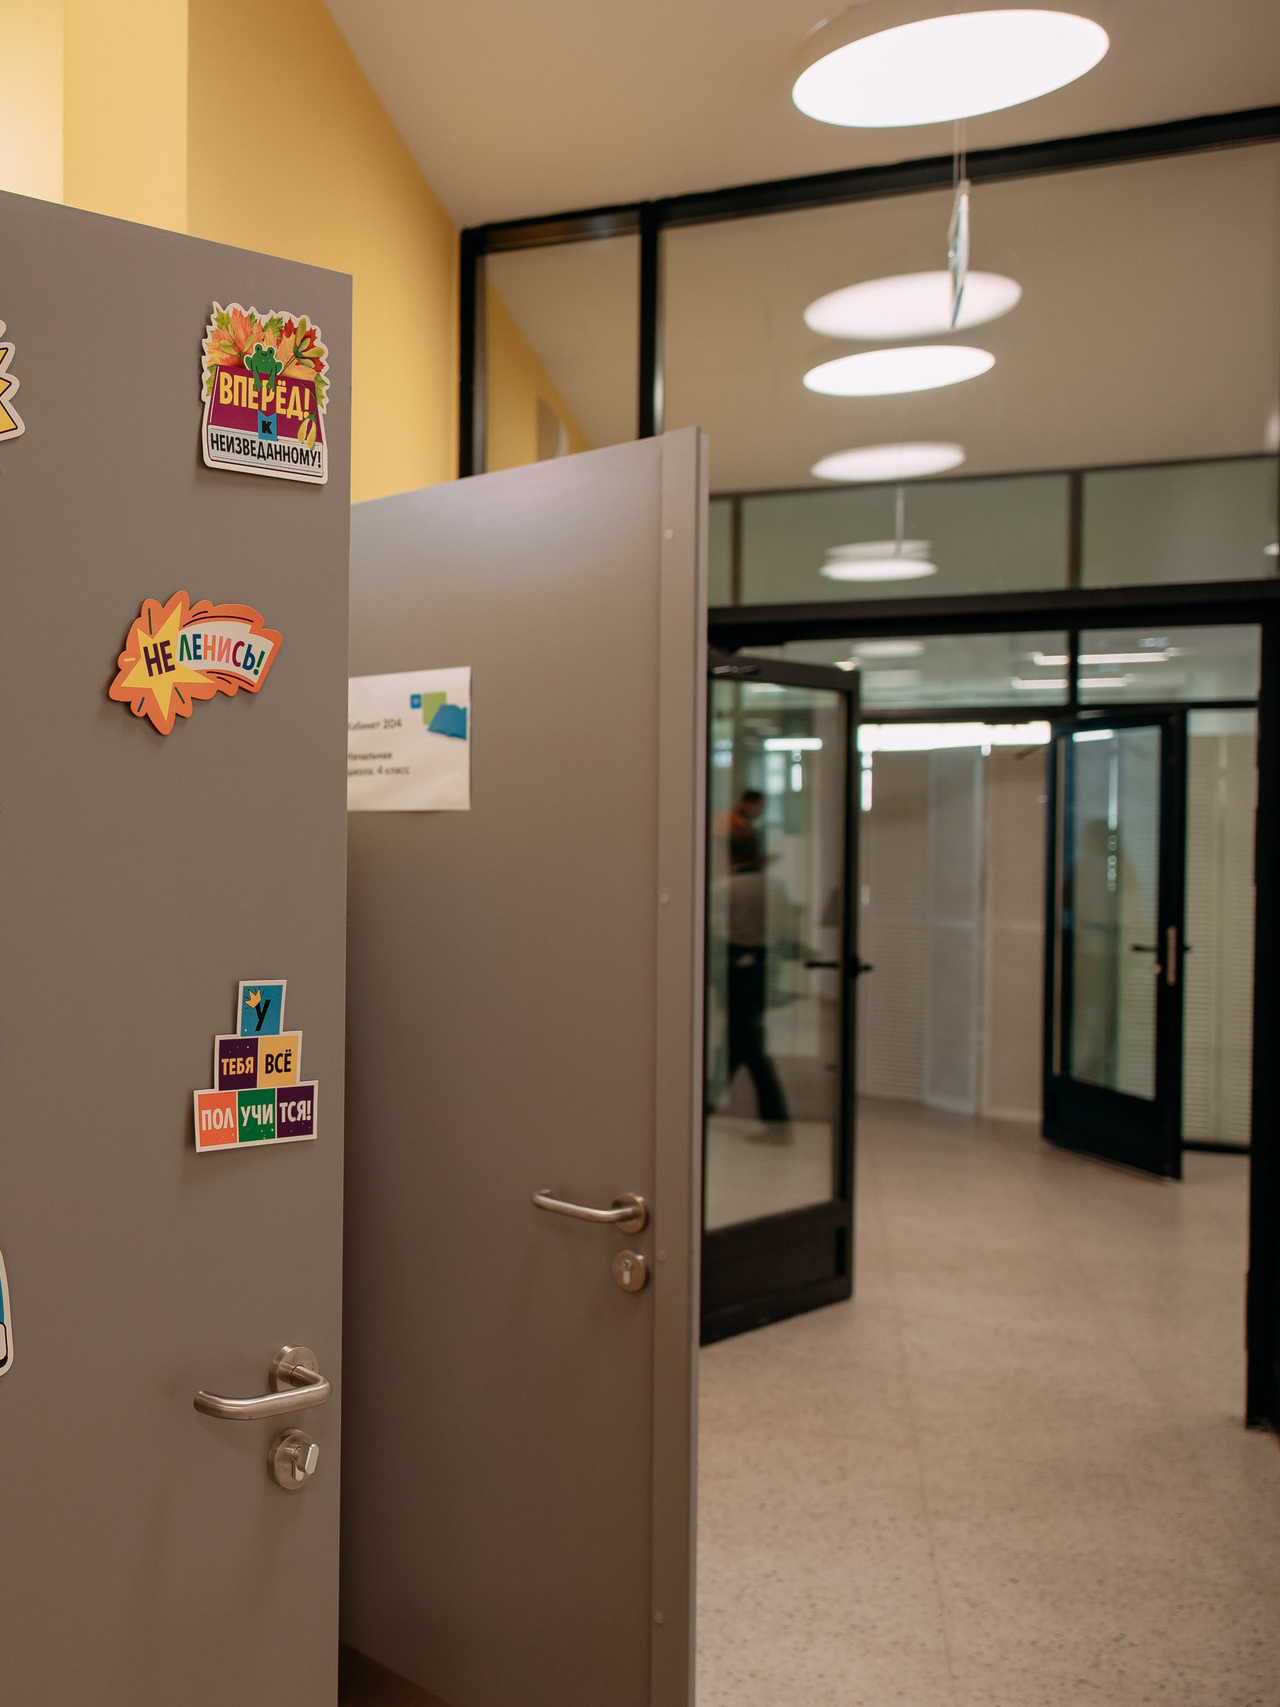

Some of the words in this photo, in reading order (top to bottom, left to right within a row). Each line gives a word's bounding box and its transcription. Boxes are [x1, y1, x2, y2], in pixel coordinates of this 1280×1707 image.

[219, 371, 311, 421] ВПЕРЁД!
[261, 420, 273, 435] К
[210, 432, 322, 469] НЕИЗВЕДАННОМУ!
[142, 639, 176, 678] НЕ
[179, 633, 266, 676] ЛЕНИСЬ!
[253, 999, 271, 1031] У
[221, 1056, 254, 1076] ТЕБЯ
[264, 1049, 292, 1075] ВСЁ
